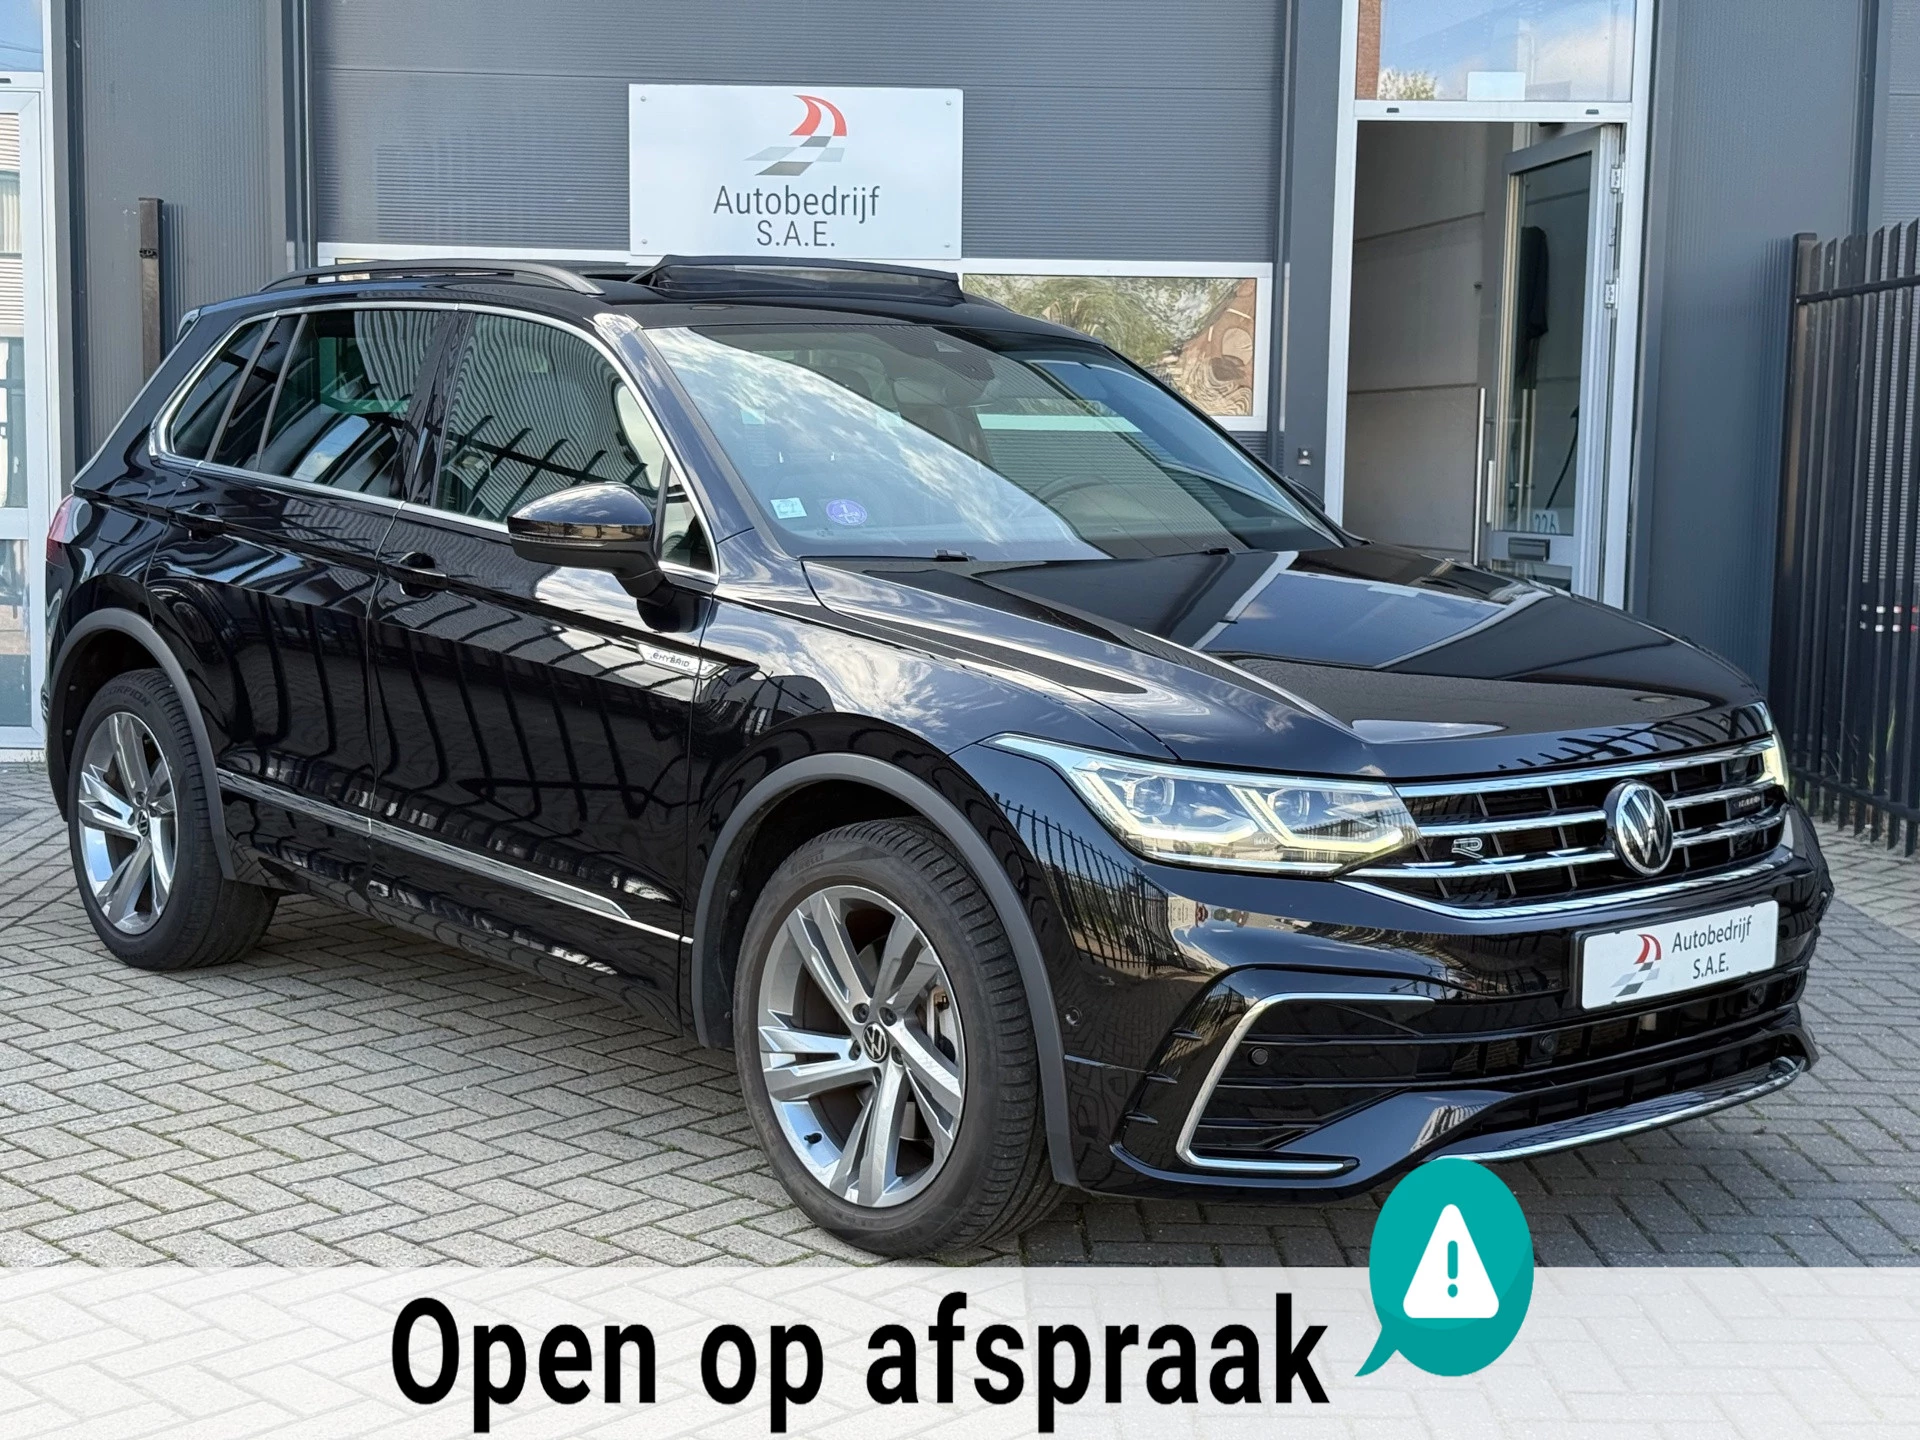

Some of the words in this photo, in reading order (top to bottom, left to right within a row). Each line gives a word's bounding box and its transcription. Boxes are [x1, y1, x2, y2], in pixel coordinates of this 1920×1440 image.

[713, 184, 880, 224] Autobedrijf
[756, 219, 835, 247] S.A.E.
[1671, 914, 1753, 954] Autobedrijf
[1692, 952, 1730, 980] S.A.E.
